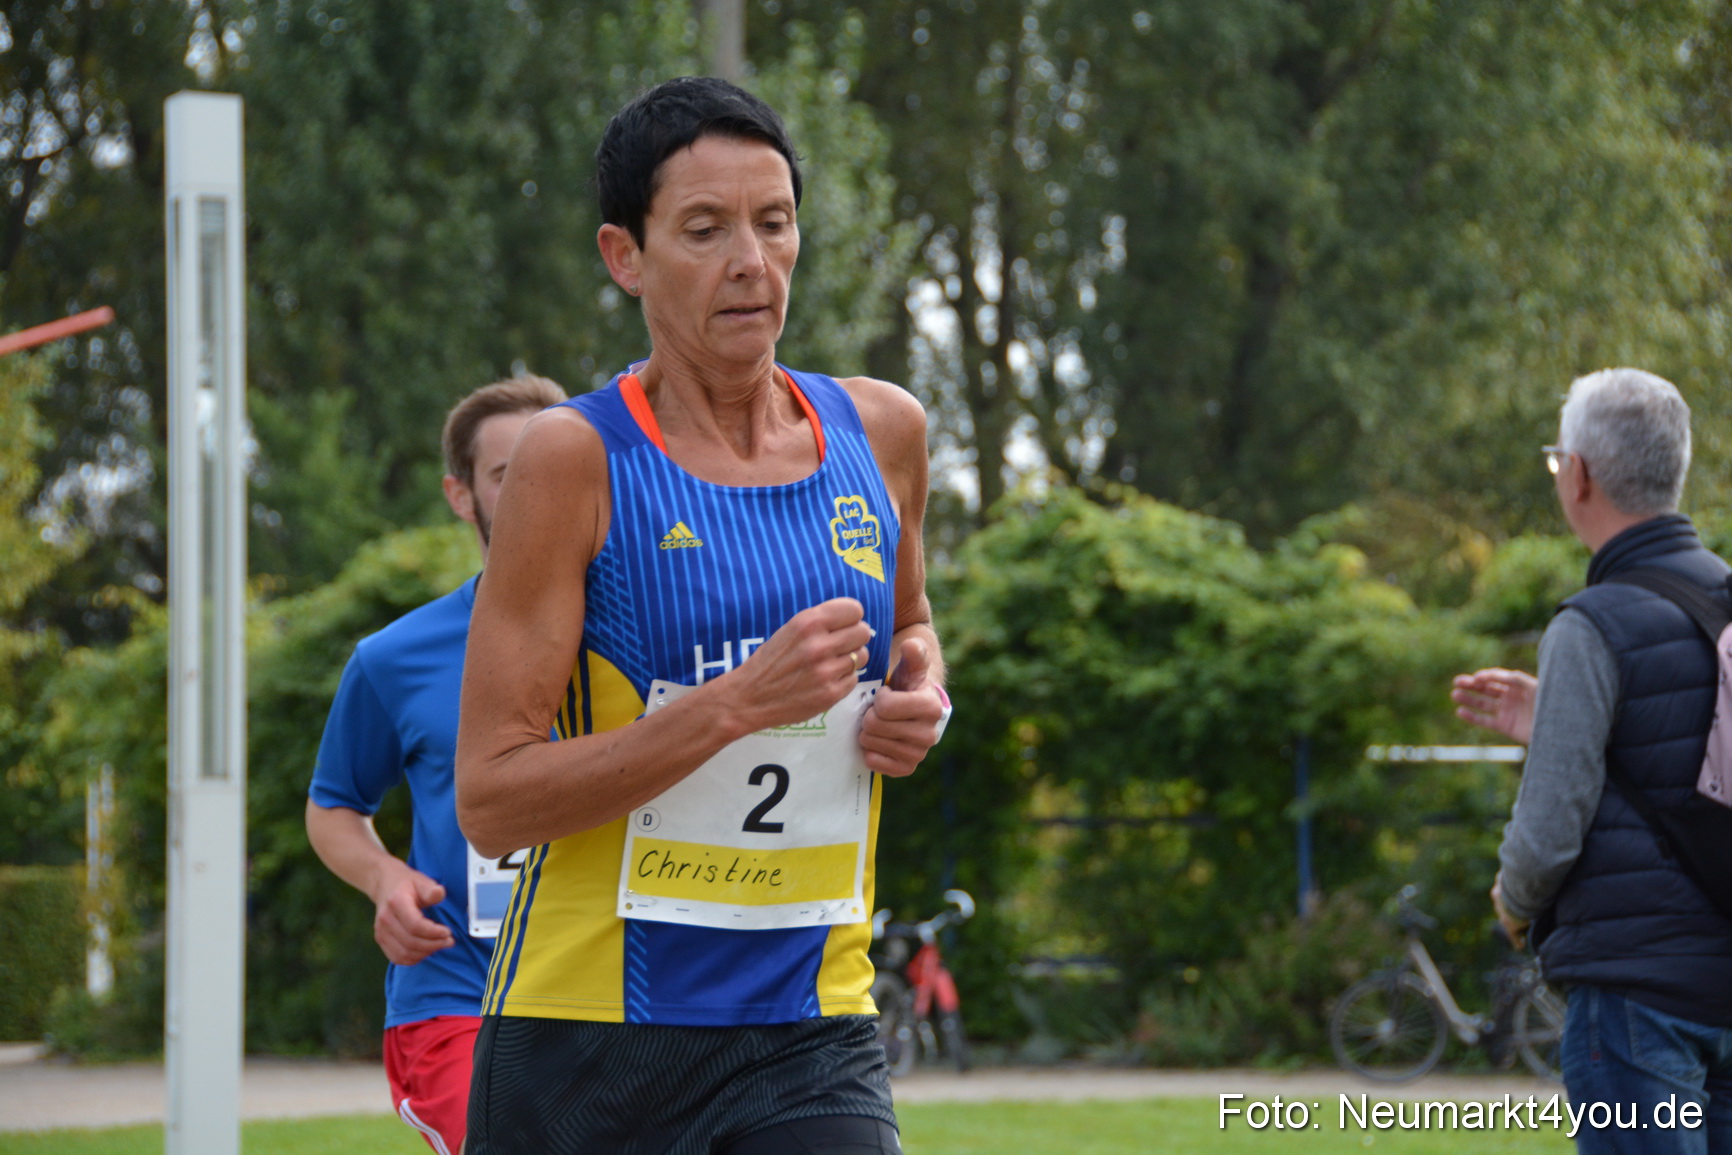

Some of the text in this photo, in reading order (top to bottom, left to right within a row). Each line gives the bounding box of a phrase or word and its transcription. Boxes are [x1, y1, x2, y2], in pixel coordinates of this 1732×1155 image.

[841, 527, 873, 540] QUELLE
[659, 538, 704, 550] adidas
[741, 763, 790, 834] 2
[642, 813, 653, 826] D
[637, 849, 784, 887] Christine
